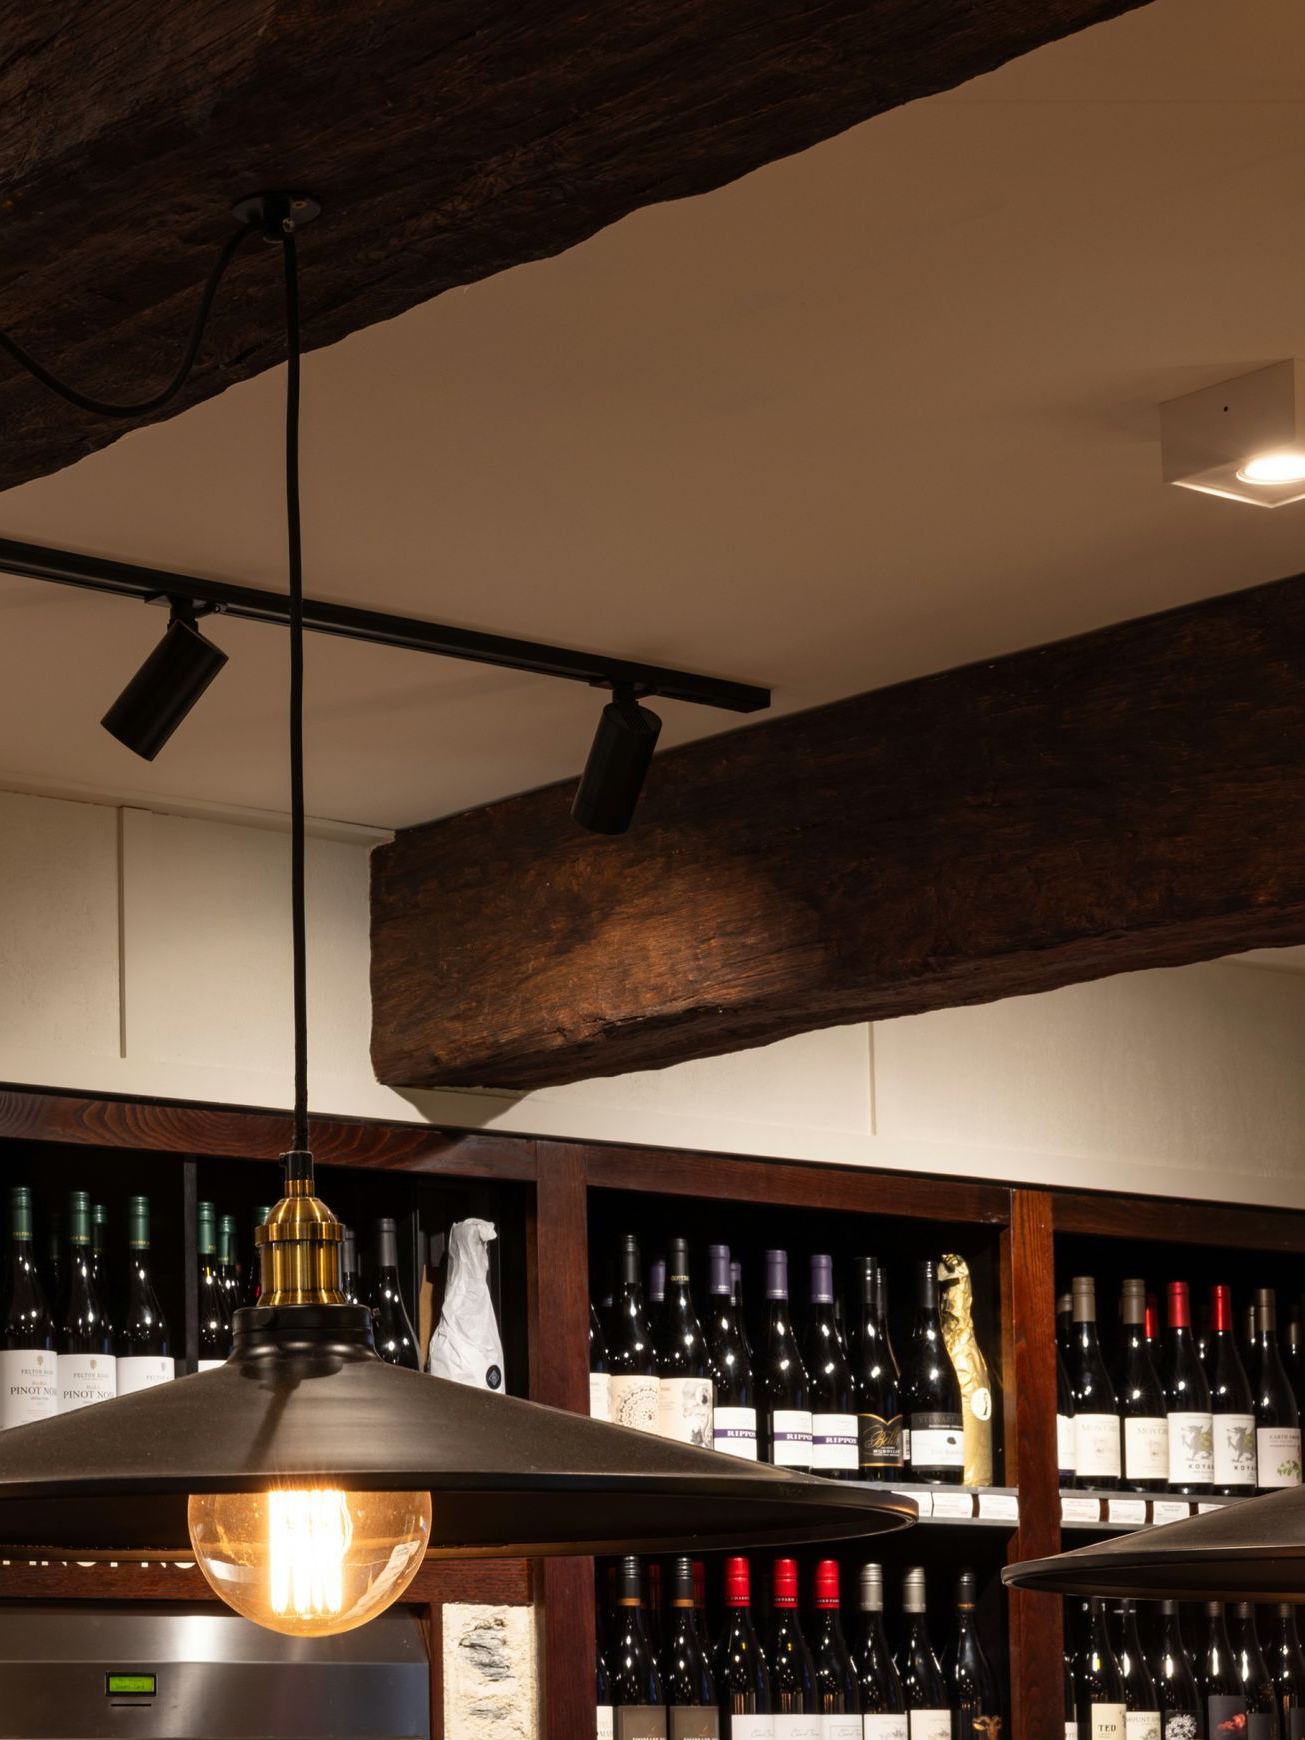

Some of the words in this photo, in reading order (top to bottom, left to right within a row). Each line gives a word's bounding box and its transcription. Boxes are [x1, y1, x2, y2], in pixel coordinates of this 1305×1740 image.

[10, 1386, 41, 1395] PINOT
[63, 1391, 94, 1399] PINOT
[1098, 1724, 1116, 1732] TED
